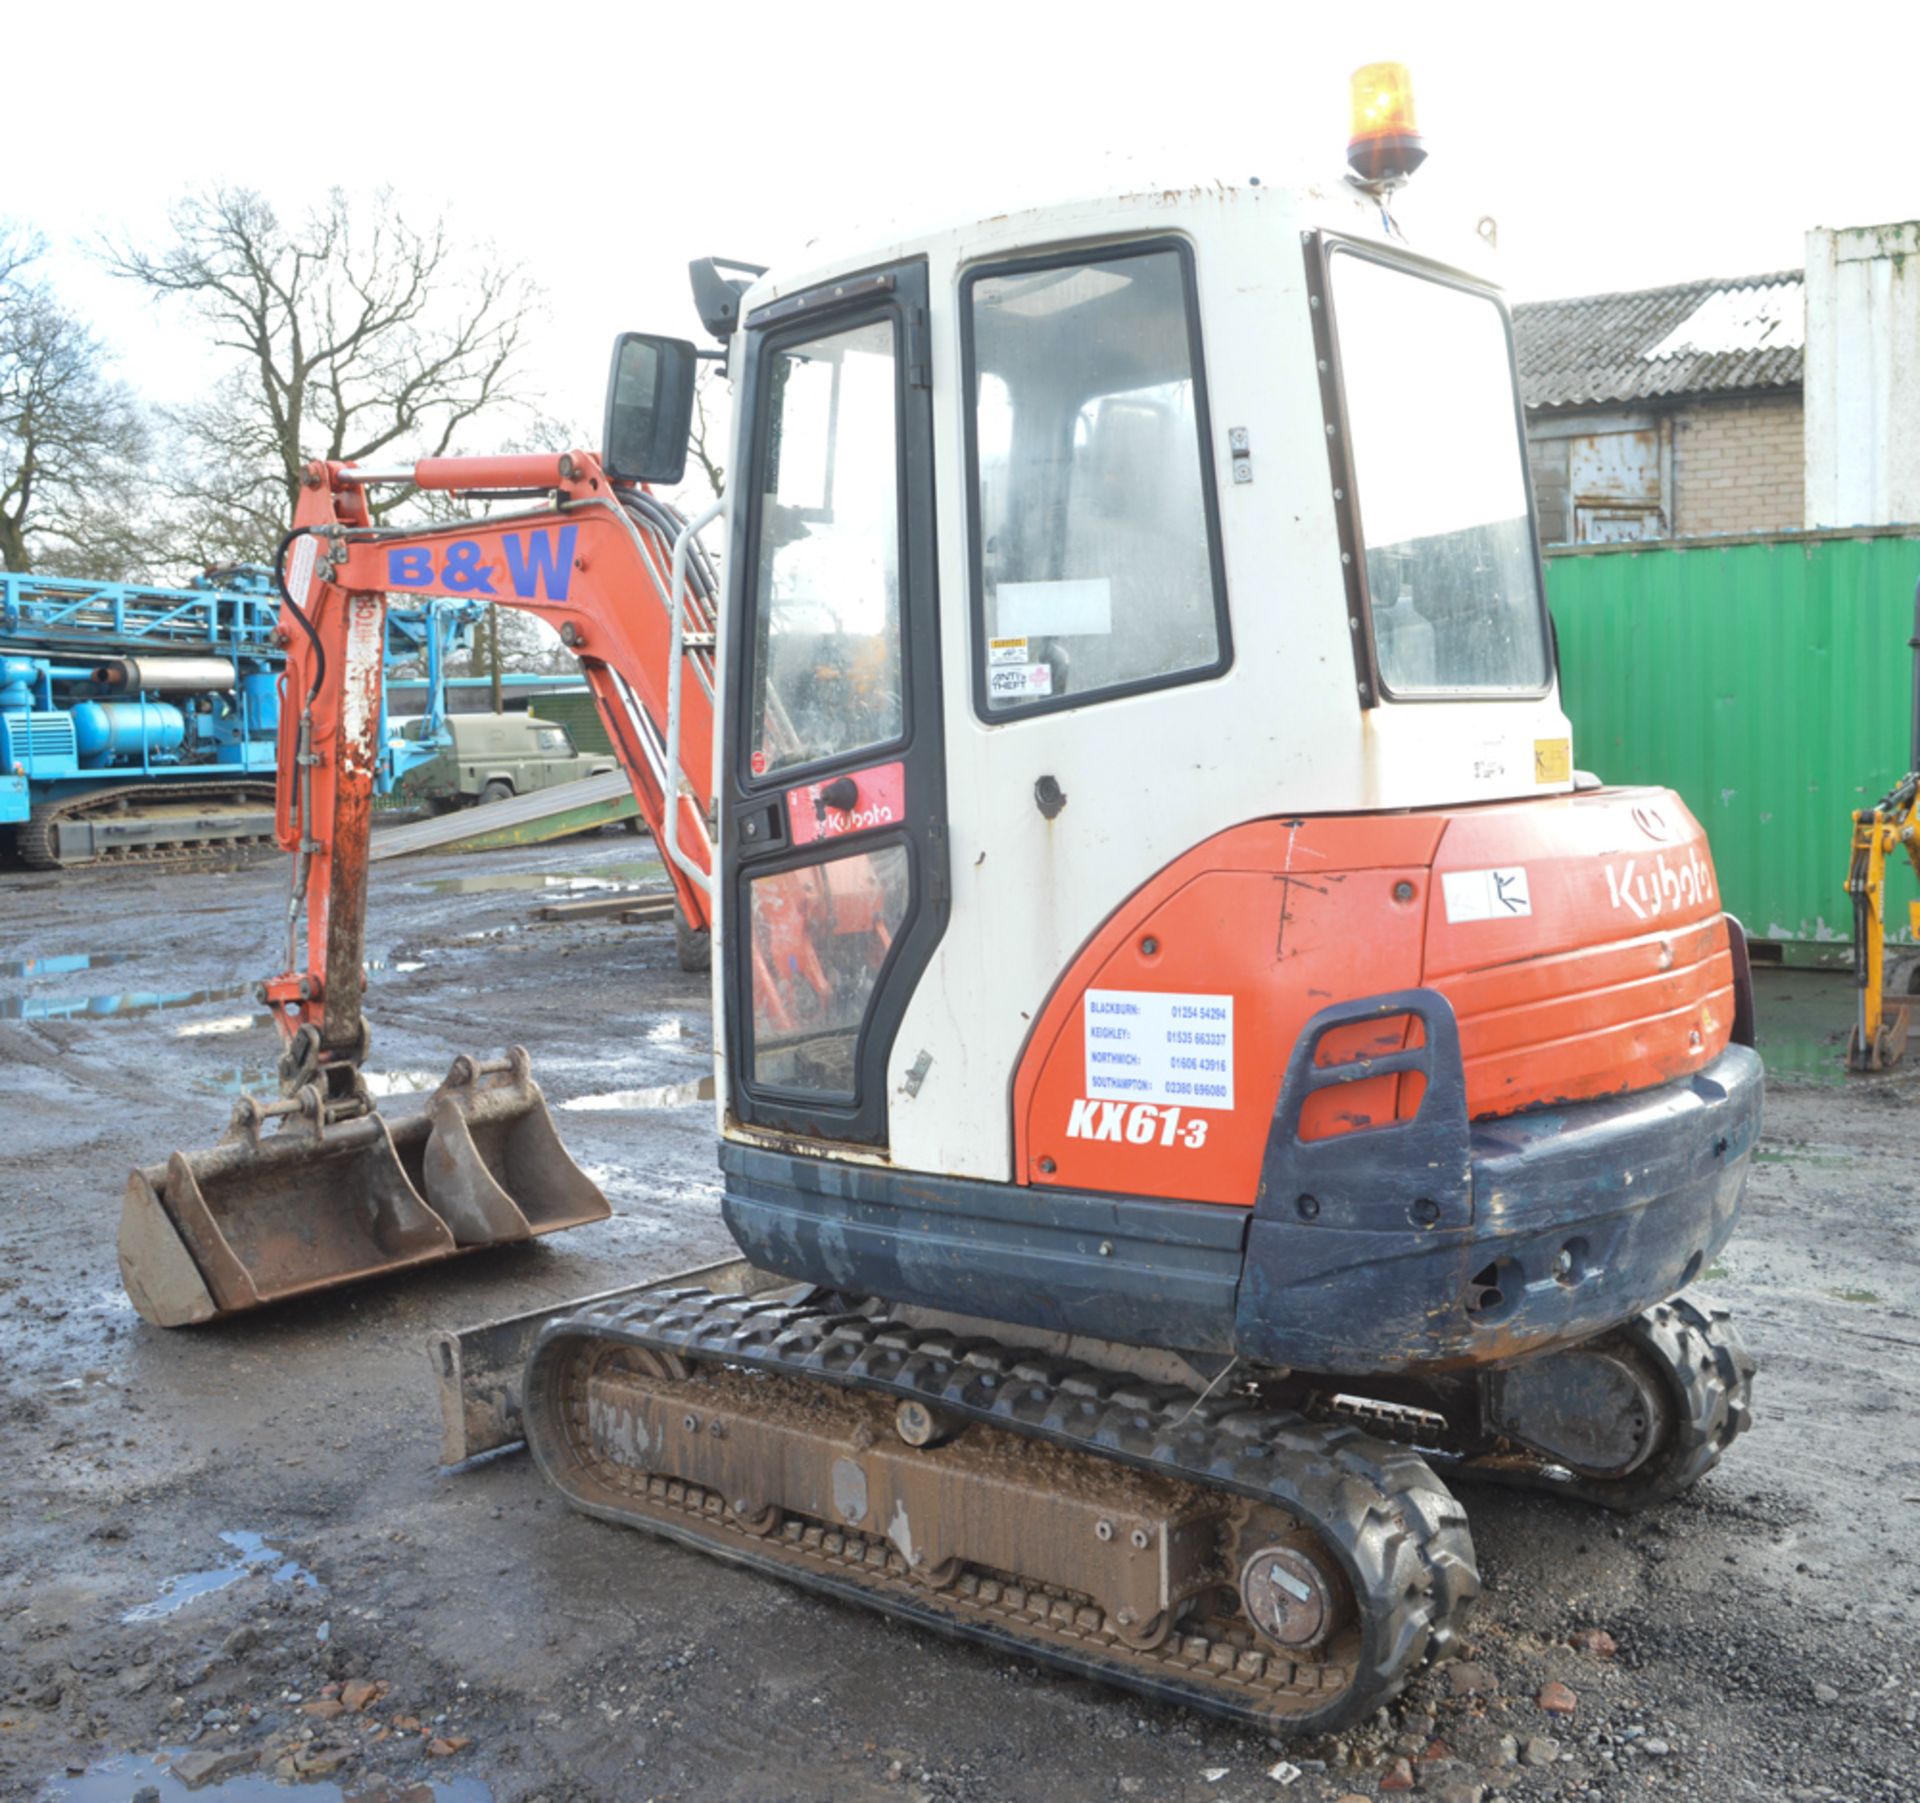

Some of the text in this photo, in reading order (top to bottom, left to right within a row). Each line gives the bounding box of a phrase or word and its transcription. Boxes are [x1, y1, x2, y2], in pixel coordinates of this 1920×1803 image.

[388, 524, 579, 601] B&W
[829, 804, 892, 832] Kubota
[1604, 847, 1713, 918] Kubota
[1090, 1001, 1226, 1020] BLACKBURN: 01254 54294
[1090, 1027, 1226, 1046] KEIGHLEY: 01535 663337
[1091, 1052, 1226, 1072] NORTHWICH: 01606 43916
[1165, 1081, 1192, 1095] 02380
[1065, 1099, 1208, 1149] KX61-3
